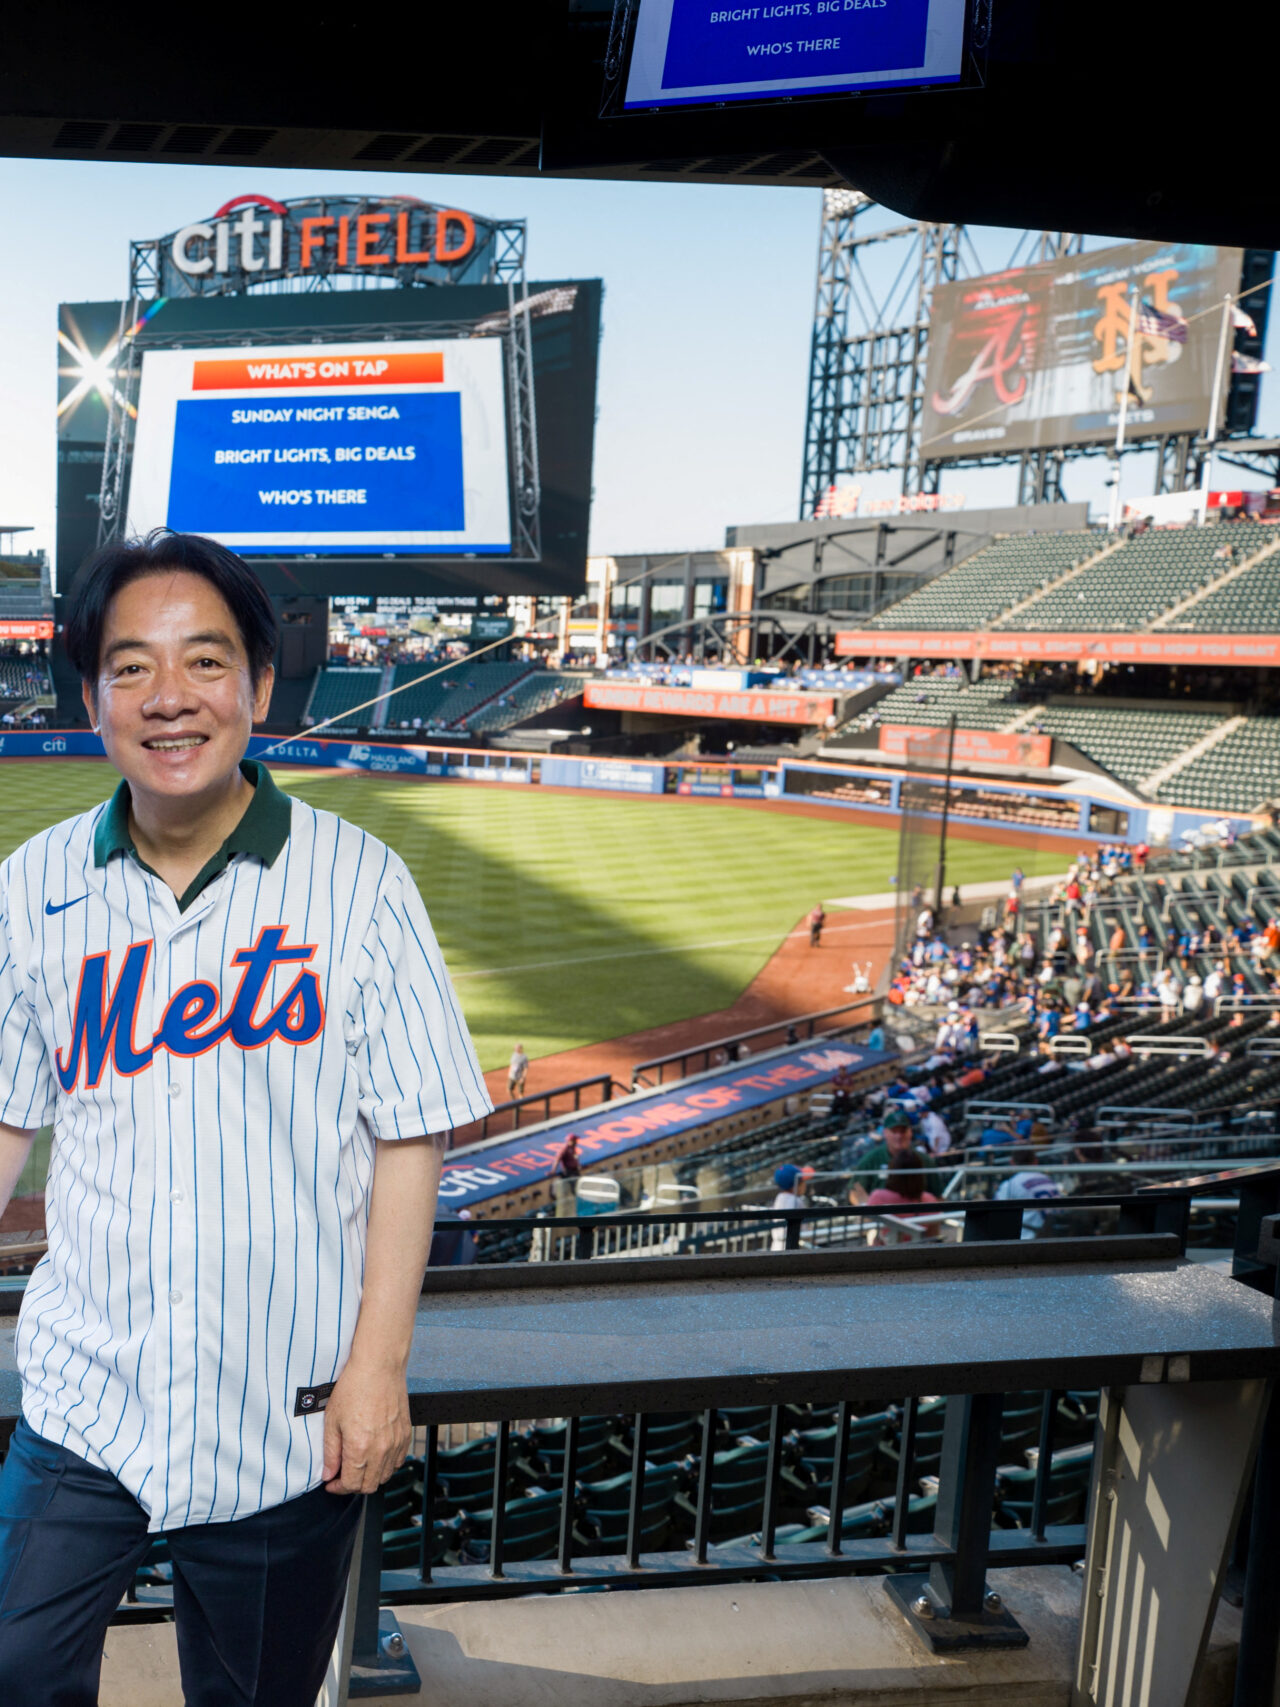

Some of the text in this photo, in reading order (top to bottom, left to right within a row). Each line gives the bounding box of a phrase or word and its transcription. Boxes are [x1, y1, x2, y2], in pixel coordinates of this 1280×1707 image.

[710, 8, 760, 23] BRIGHT
[763, 4, 812, 18] LIGHTS,
[817, 0, 840, 14] BIG
[746, 38, 840, 56] WHO'S THERE
[172, 205, 476, 274] citi FIELD
[1094, 256, 1176, 285] NEW YORK
[972, 293, 1031, 311] ATLANTA
[247, 360, 388, 380] WHAT'S ON TAP
[232, 406, 400, 424] SUNDAY NIGHT SENGA
[952, 426, 1006, 443] BRAVES
[214, 446, 416, 464] BRIGHT LIGHTS, BIG DEALS
[259, 489, 367, 505] WHO'S THERE
[719, 696, 750, 714] ARE
[754, 698, 767, 715] A
[768, 699, 799, 717] HIT
[43, 739, 66, 751] citi
[278, 745, 318, 758] DELTA
[371, 754, 416, 766] HAUGLAND
[371, 761, 399, 772] GROUP
[54, 924, 326, 1095] Mets
[577, 1103, 702, 1150] HOME
[696, 1087, 742, 1109] OF
[732, 1064, 818, 1091] THE
